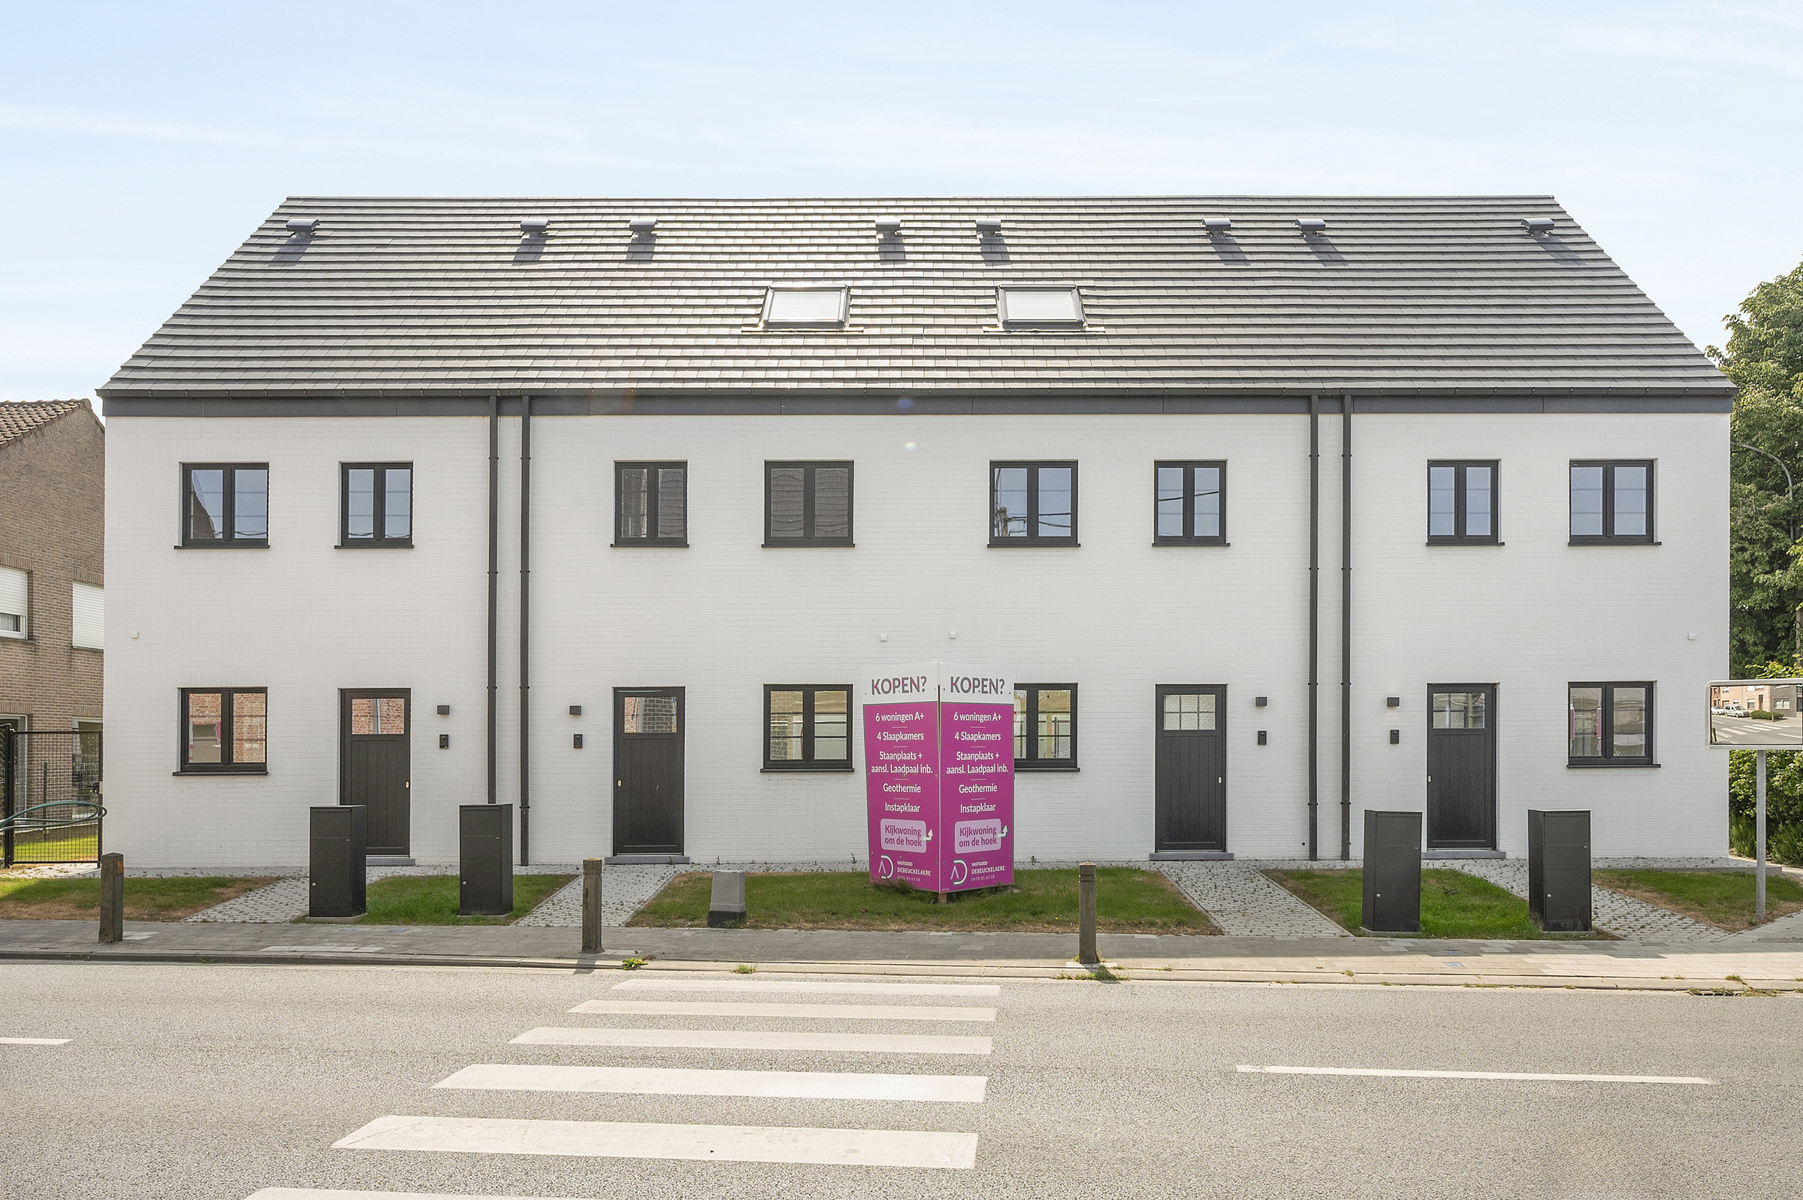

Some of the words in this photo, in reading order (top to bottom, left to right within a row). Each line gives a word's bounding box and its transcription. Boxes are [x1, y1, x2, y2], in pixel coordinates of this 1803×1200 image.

[871, 675, 927, 695] KOPEN?
[950, 676, 1005, 695] KOPEN?
[875, 712, 880, 722] 6
[881, 712, 913, 723] woningen
[914, 711, 924, 721] A+
[953, 712, 958, 721] 6
[959, 712, 991, 723] woningen
[992, 712, 1002, 722] A+
[876, 731, 882, 741] 4
[882, 731, 924, 742] Slaapkamers
[954, 731, 960, 741] 4
[960, 731, 1001, 742] Slaapkamers
[879, 751, 916, 762] Staanplaats
[956, 751, 994, 761] Staanplaats
[871, 764, 889, 773] aansl.
[890, 763, 919, 775] Laadpaal
[920, 764, 933, 774] inb.
[946, 765, 966, 774] aansl.
[967, 764, 996, 775] Laadpaal
[997, 764, 1009, 773] inb.
[882, 783, 921, 793] Geothermie
[958, 783, 998, 794] Geothermie
[884, 802, 920, 813] Instapklaar
[960, 802, 996, 814] Instapklaar
[884, 825, 921, 838] Kijkwoning
[959, 825, 997, 838] Kijkwoning
[896, 836, 905, 845] de
[905, 836, 922, 847] hoek
[959, 840, 970, 848] om
[971, 837, 980, 846] de
[980, 836, 998, 846] hoek
